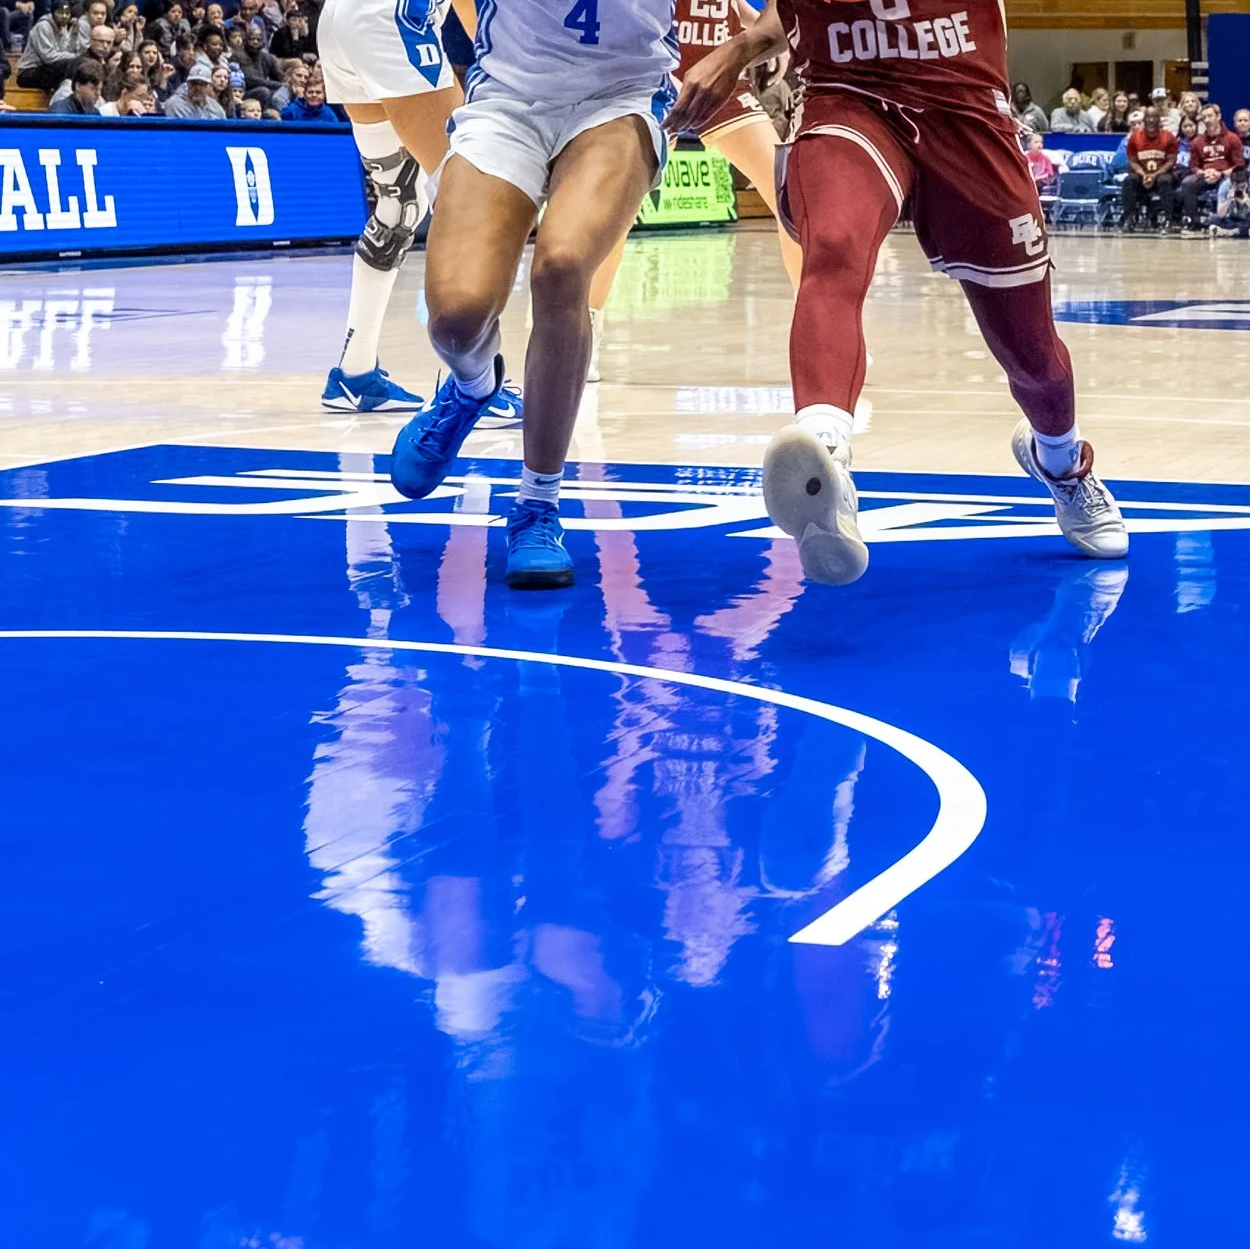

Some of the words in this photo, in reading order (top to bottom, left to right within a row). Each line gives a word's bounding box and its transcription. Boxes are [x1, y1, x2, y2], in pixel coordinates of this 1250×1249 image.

[415, 43, 439, 68] D
[827, 11, 977, 63] COLLEGE
[226, 146, 275, 226] D
